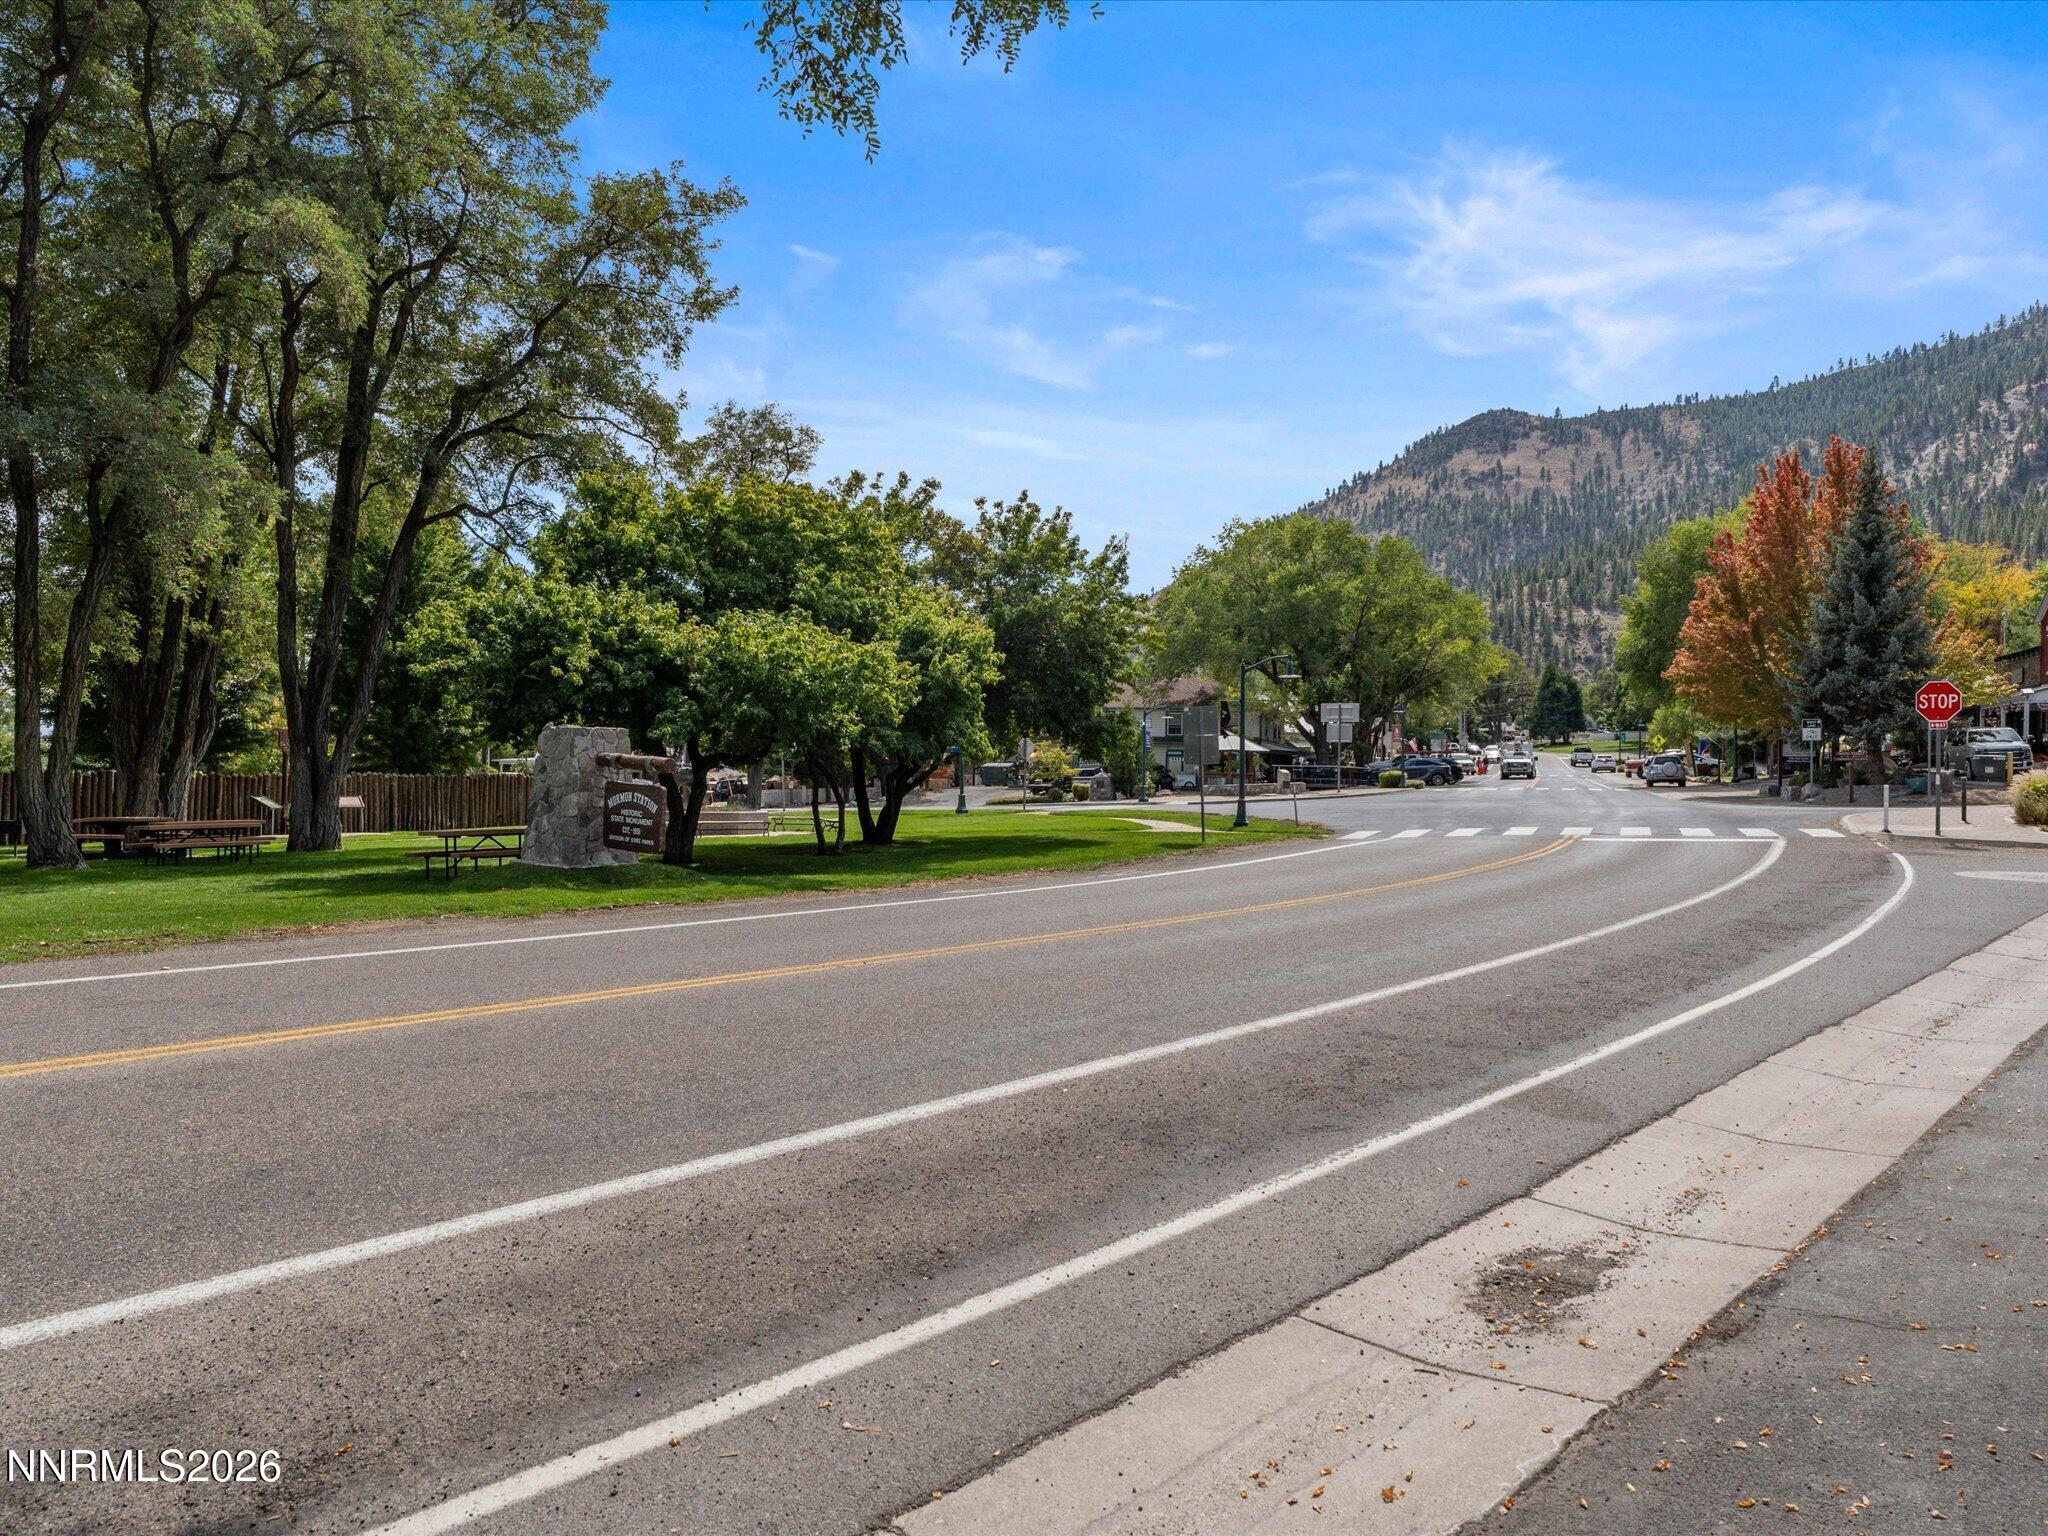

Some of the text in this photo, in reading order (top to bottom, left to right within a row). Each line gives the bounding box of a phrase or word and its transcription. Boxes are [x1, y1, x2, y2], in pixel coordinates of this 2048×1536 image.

[1919, 694, 1958, 709] STOP
[607, 792, 658, 814] MORMON STATION
[621, 809, 643, 817] HISTORIC
[625, 816, 653, 826] MONUMENT
